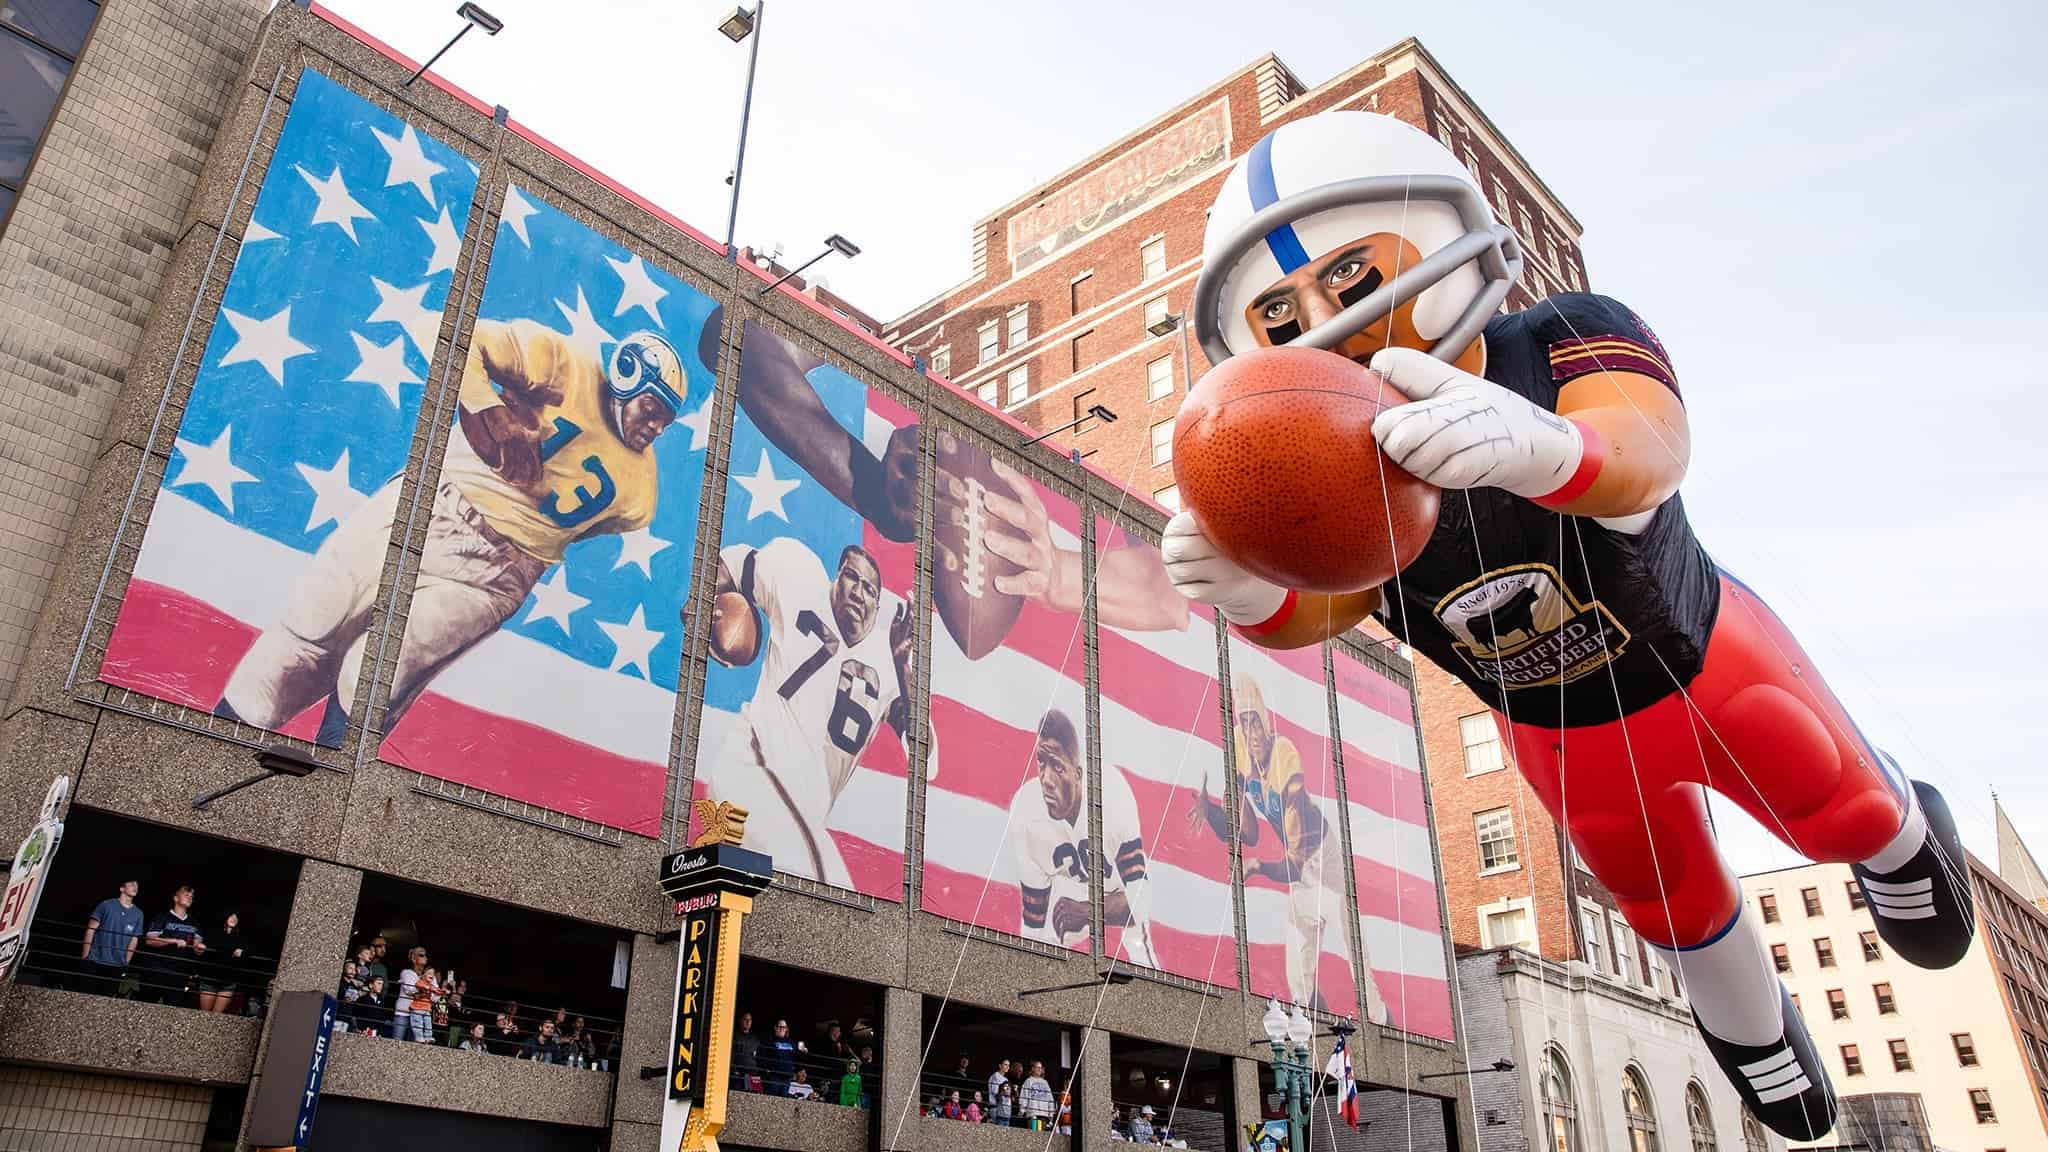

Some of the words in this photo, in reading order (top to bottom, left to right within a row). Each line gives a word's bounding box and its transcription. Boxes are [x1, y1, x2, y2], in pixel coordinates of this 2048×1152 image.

[538, 416, 617, 528] 13
[1457, 587, 1491, 611] SINCE
[1494, 578, 1525, 594] 1978
[1477, 623, 1588, 673] CERTIFIED
[1482, 662, 1557, 683] ANGUS
[777, 609, 881, 756] 76
[671, 854, 708, 873] Onesto
[673, 892, 718, 915] PUBLIC
[675, 919, 706, 1092] PARKING
[305, 1035, 326, 1108] EXIT
